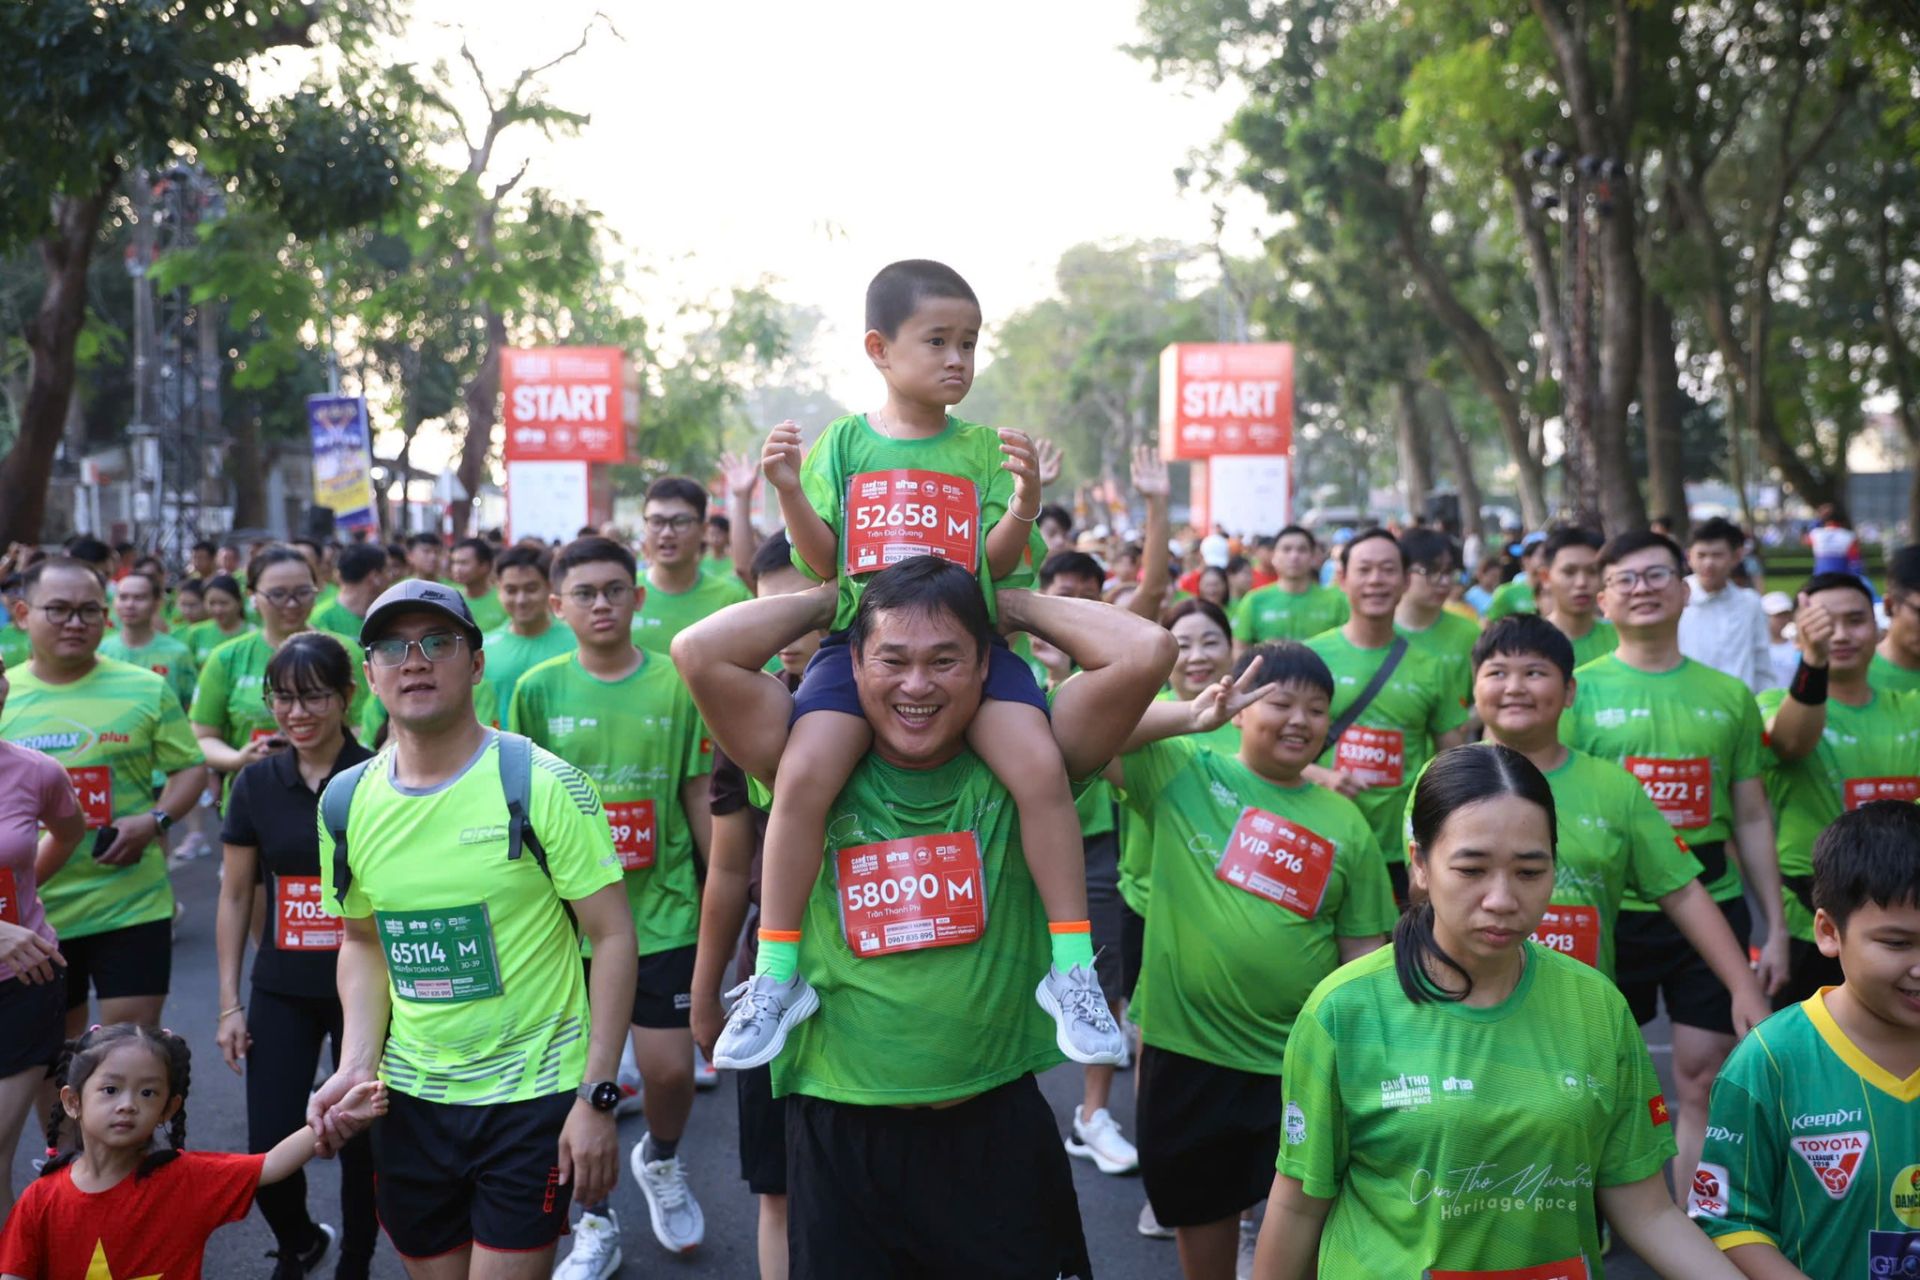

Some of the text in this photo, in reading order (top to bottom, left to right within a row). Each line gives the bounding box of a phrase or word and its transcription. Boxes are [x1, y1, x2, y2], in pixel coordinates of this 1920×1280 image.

[513, 385, 611, 421] START
[1183, 381, 1279, 417] START
[856, 504, 969, 539] 52658 M
[16, 731, 129, 749] COMAX plus
[89, 791, 106, 805] M
[1695, 785, 1705, 802] F
[636, 827, 651, 844] M
[1240, 832, 1303, 874] VIP-916
[848, 873, 973, 911] 58090 M
[284, 900, 338, 919] 7103
[391, 939, 478, 964] 65114 M
[1381, 1075, 1429, 1091] CAN THO
[1792, 1108, 1862, 1130] KeepDri
[1705, 1125, 1745, 1144] pDri
[1798, 1137, 1863, 1152] TOYOTA
[1440, 1196, 1578, 1220] Heritage Race
